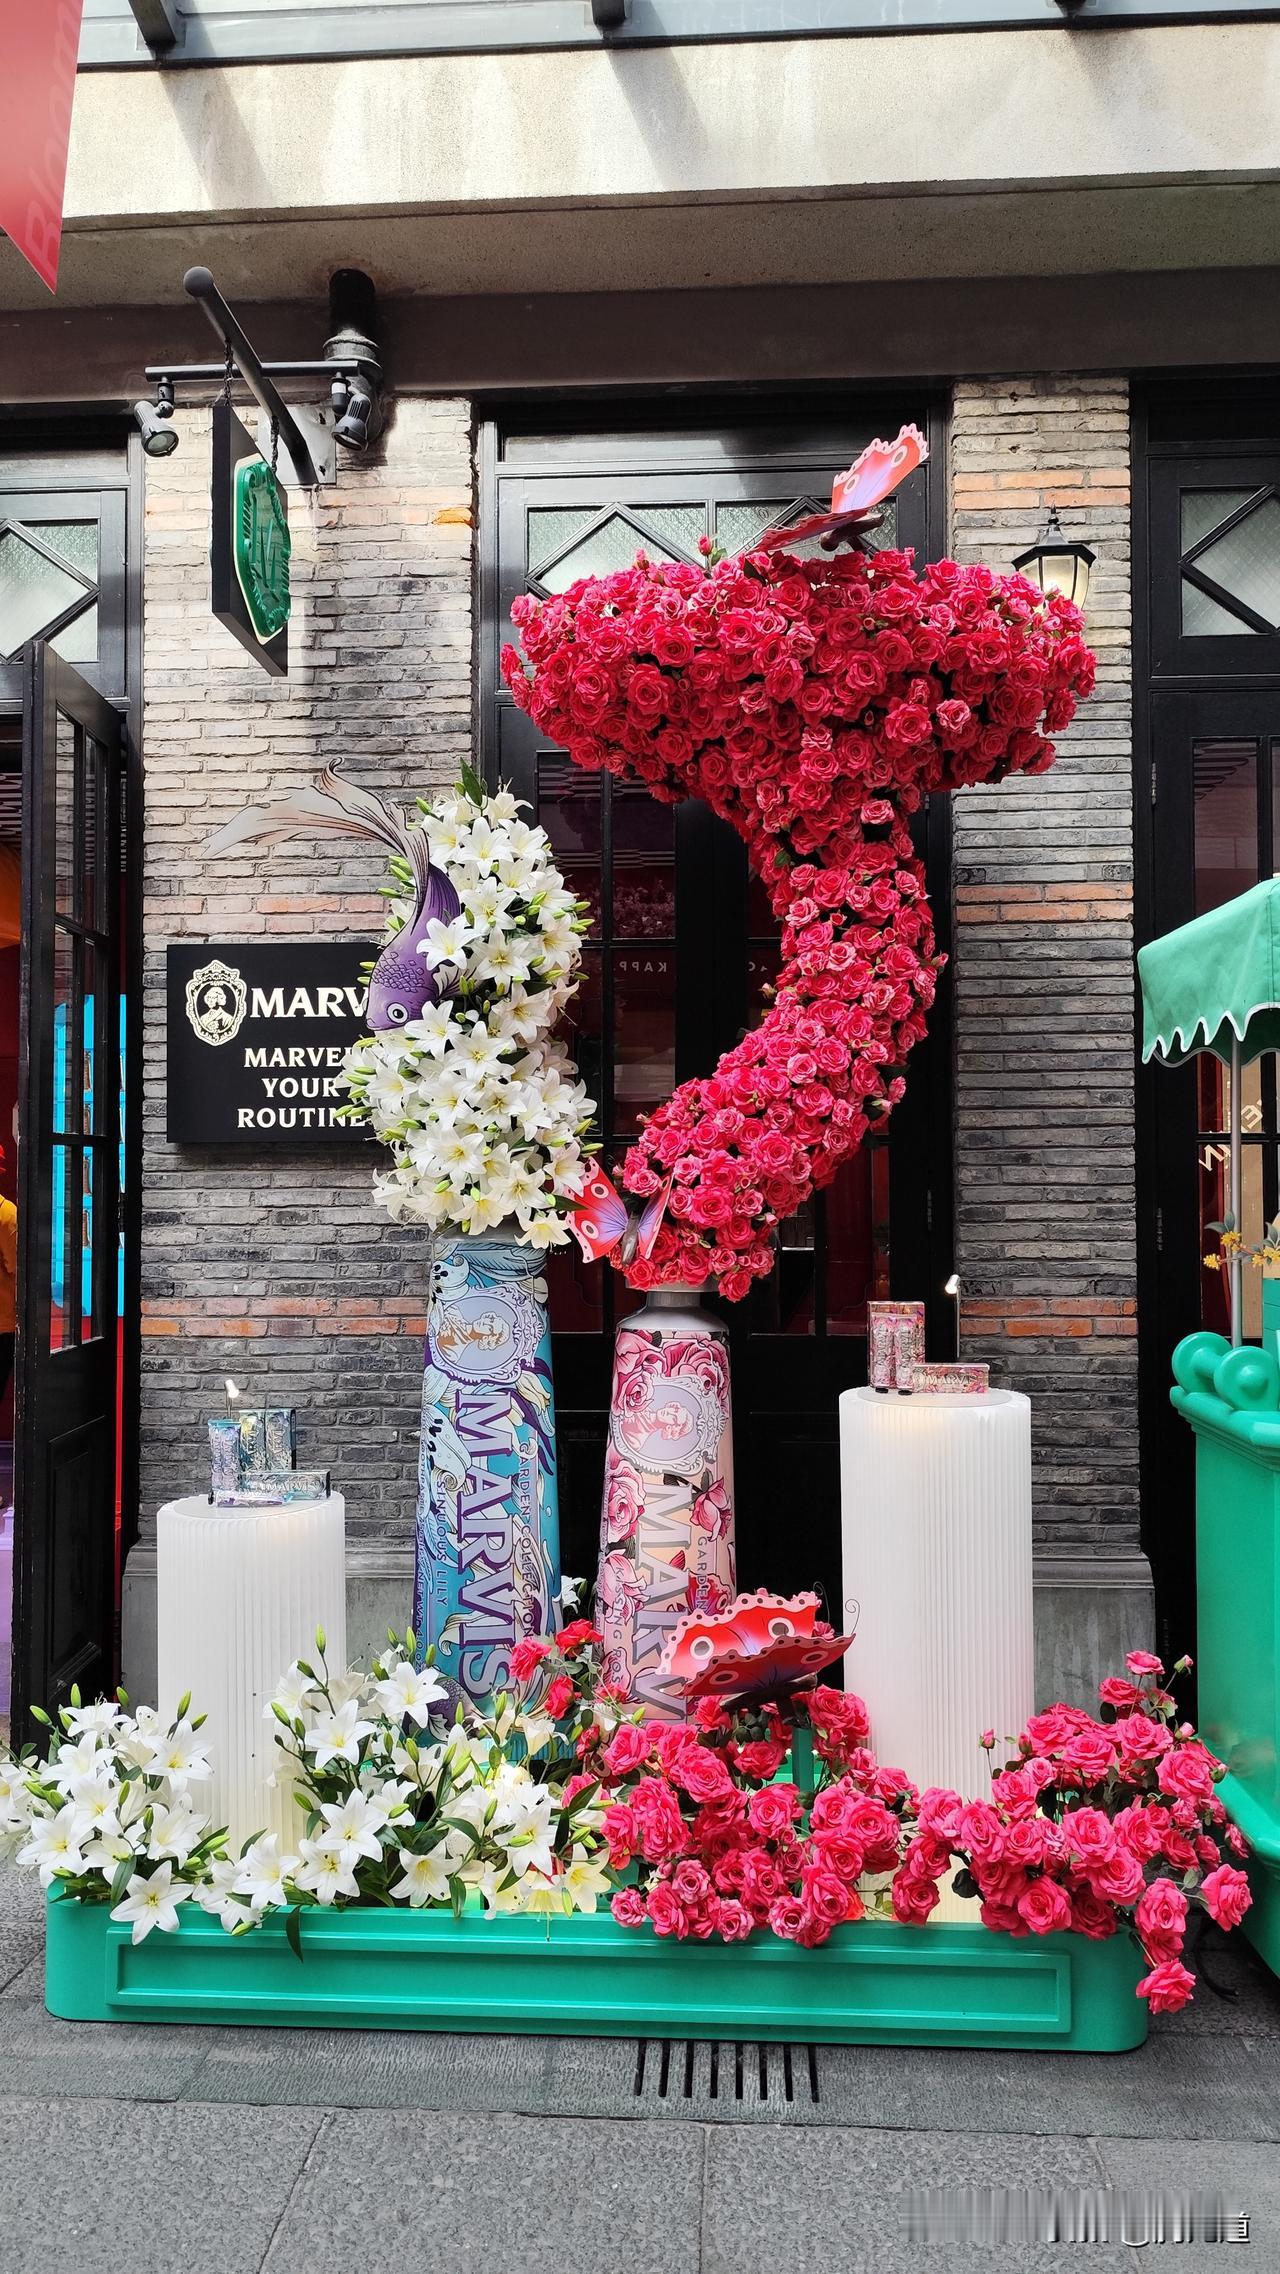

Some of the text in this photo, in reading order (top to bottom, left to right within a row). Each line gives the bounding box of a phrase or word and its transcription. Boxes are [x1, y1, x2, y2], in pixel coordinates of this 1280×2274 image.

[250, 987, 370, 1018] MARV
[261, 1077, 341, 1098] YOUR
[436, 1480, 448, 1606] SINUOUS LILY
[453, 1389, 518, 1698] MARVIS
[519, 1442, 534, 1638] GARDEN COLLECTION
[696, 1536, 707, 1610] GARDEN
[610, 1565, 625, 1684] KISSING ROS
[632, 1484, 693, 1721] MARV
